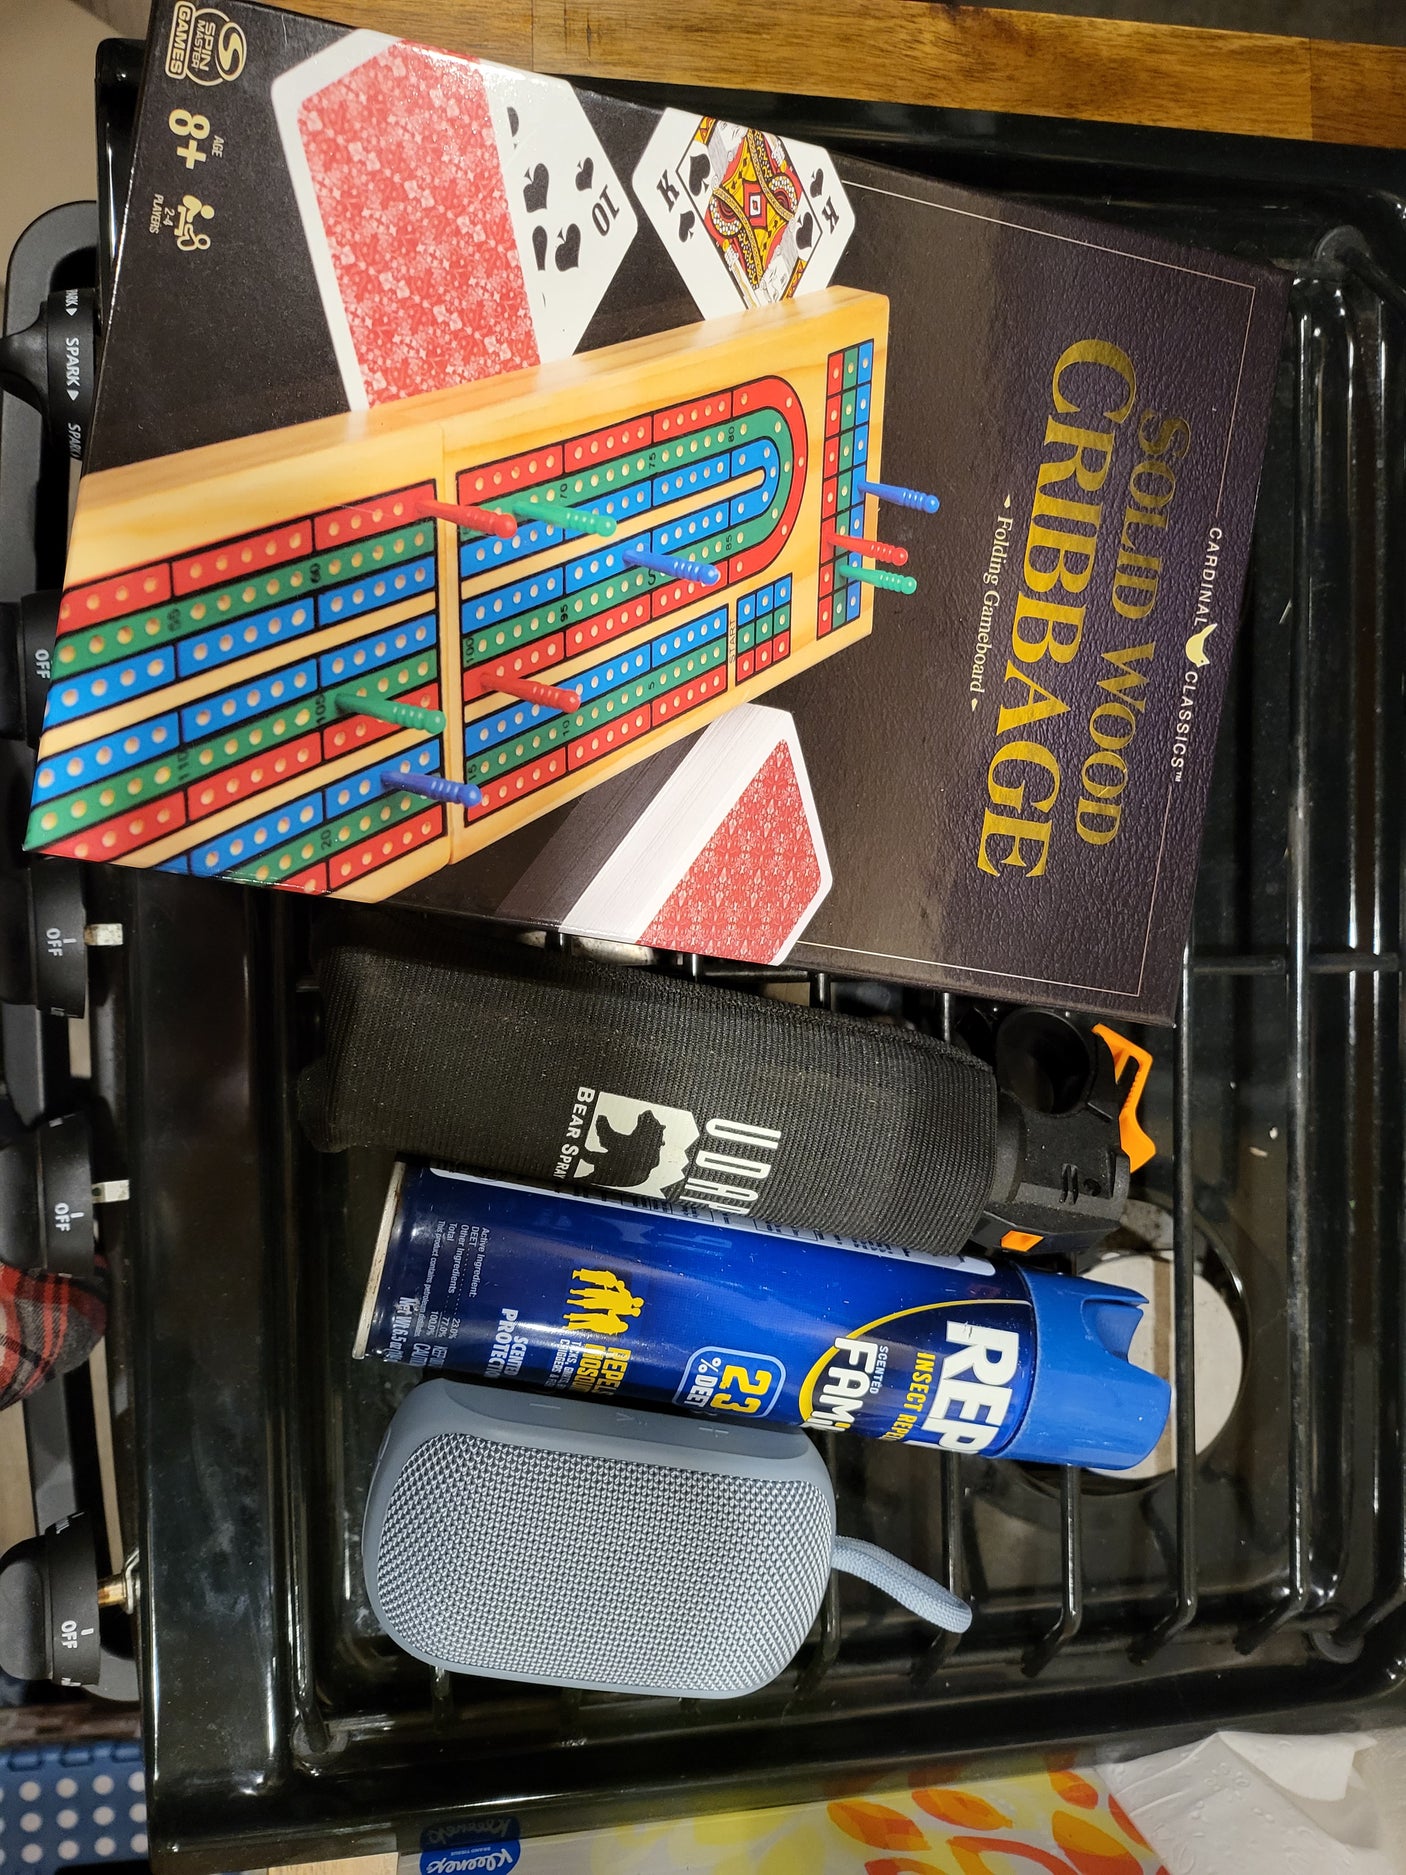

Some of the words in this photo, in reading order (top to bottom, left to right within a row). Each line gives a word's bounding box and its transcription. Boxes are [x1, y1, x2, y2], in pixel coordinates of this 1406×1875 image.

[170, 6, 191, 73] GAMES
[190, 20, 205, 68] MASTER
[198, 22, 216, 71] SPIN
[168, 109, 211, 169] 8+
[211, 135, 225, 158] AGE
[591, 184, 620, 237] 10
[656, 169, 680, 213] K
[148, 194, 164, 234] PLAYERS
[163, 207, 175, 226] 2-4
[821, 196, 840, 234] K
[65, 337, 81, 387] SPARK
[648, 453, 656, 469] 75
[1112, 409, 1191, 620] SOLID
[982, 515, 1013, 586] Folding
[1194, 527, 1222, 626] CARDINAL
[977, 338, 1137, 878] CRIBBAGE
[728, 619, 736, 664] START
[970, 590, 1000, 694] Gameboard
[35, 649, 51, 679] OFF
[561, 720, 570, 737] 10
[1075, 641, 1155, 846] WOOD
[46, 928, 62, 956] OFF
[565, 1086, 596, 1138] BEAR
[552, 1143, 580, 1180] SPRAY
[54, 1203, 70, 1232] OFF
[436, 1220, 446, 1233] This
[446, 1223, 458, 1241] Total
[458, 1224, 470, 1247] Other
[468, 1226, 480, 1248] DEET
[431, 1233, 442, 1257] product
[478, 1227, 491, 1253] Active
[426, 1257, 438, 1284] contains
[447, 1247, 465, 1294] Ingredients
[468, 1253, 486, 1298] Ingredient:
[419, 1284, 432, 1313] petroleum
[390, 1328, 408, 1342] 6.5
[425, 1311, 439, 1336] 100.0%
[438, 1316, 451, 1338] 77.0%
[448, 1317, 461, 1340] 23.0%
[483, 1308, 519, 1379] PROTECTIO
[504, 1335, 528, 1376] SCENTED
[564, 1341, 582, 1365] TCKS,
[709, 1364, 773, 1414] 23
[869, 1345, 889, 1394] SCENTED
[904, 1352, 936, 1412] INSECT
[904, 1321, 1019, 1455] REP
[61, 1620, 78, 1648] OFF
[426, 1848, 513, 1874] Kleenex
